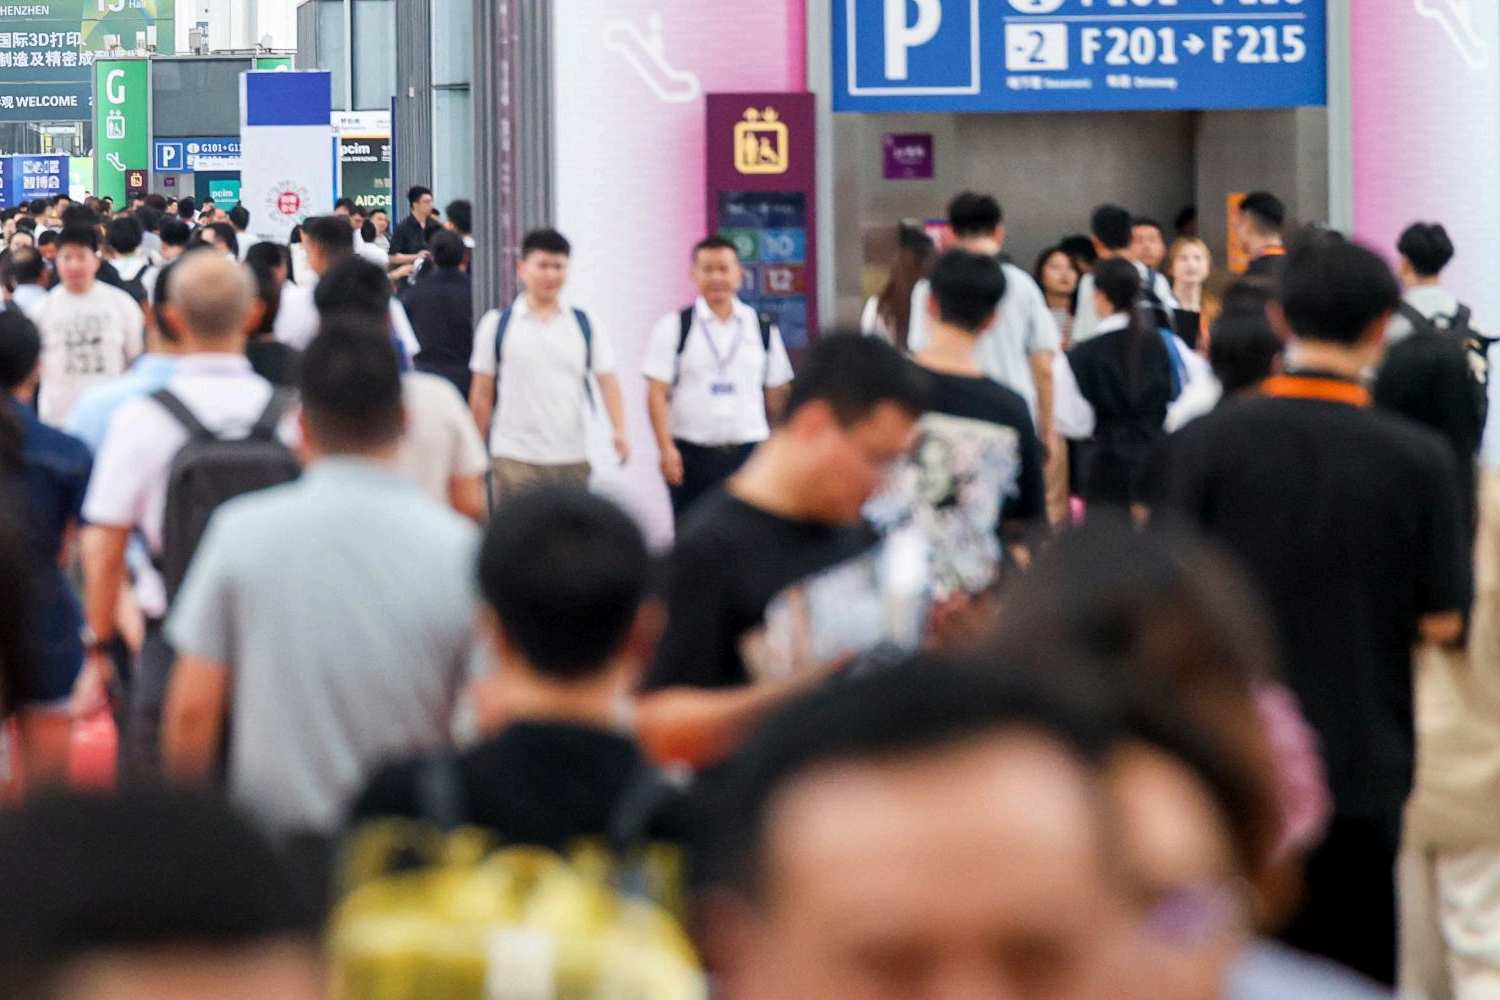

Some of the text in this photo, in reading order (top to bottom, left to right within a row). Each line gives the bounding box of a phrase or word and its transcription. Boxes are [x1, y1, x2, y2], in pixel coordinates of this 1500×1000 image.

[129, 0, 146, 9] Hall
[1016, 25, 1306, 65] -2 F201 F215
[106, 69, 125, 104] G
[16, 96, 78, 107] WELCOME
[163, 146, 175, 167] P
[201, 144, 222, 153] G101
[340, 143, 370, 156] pcim
